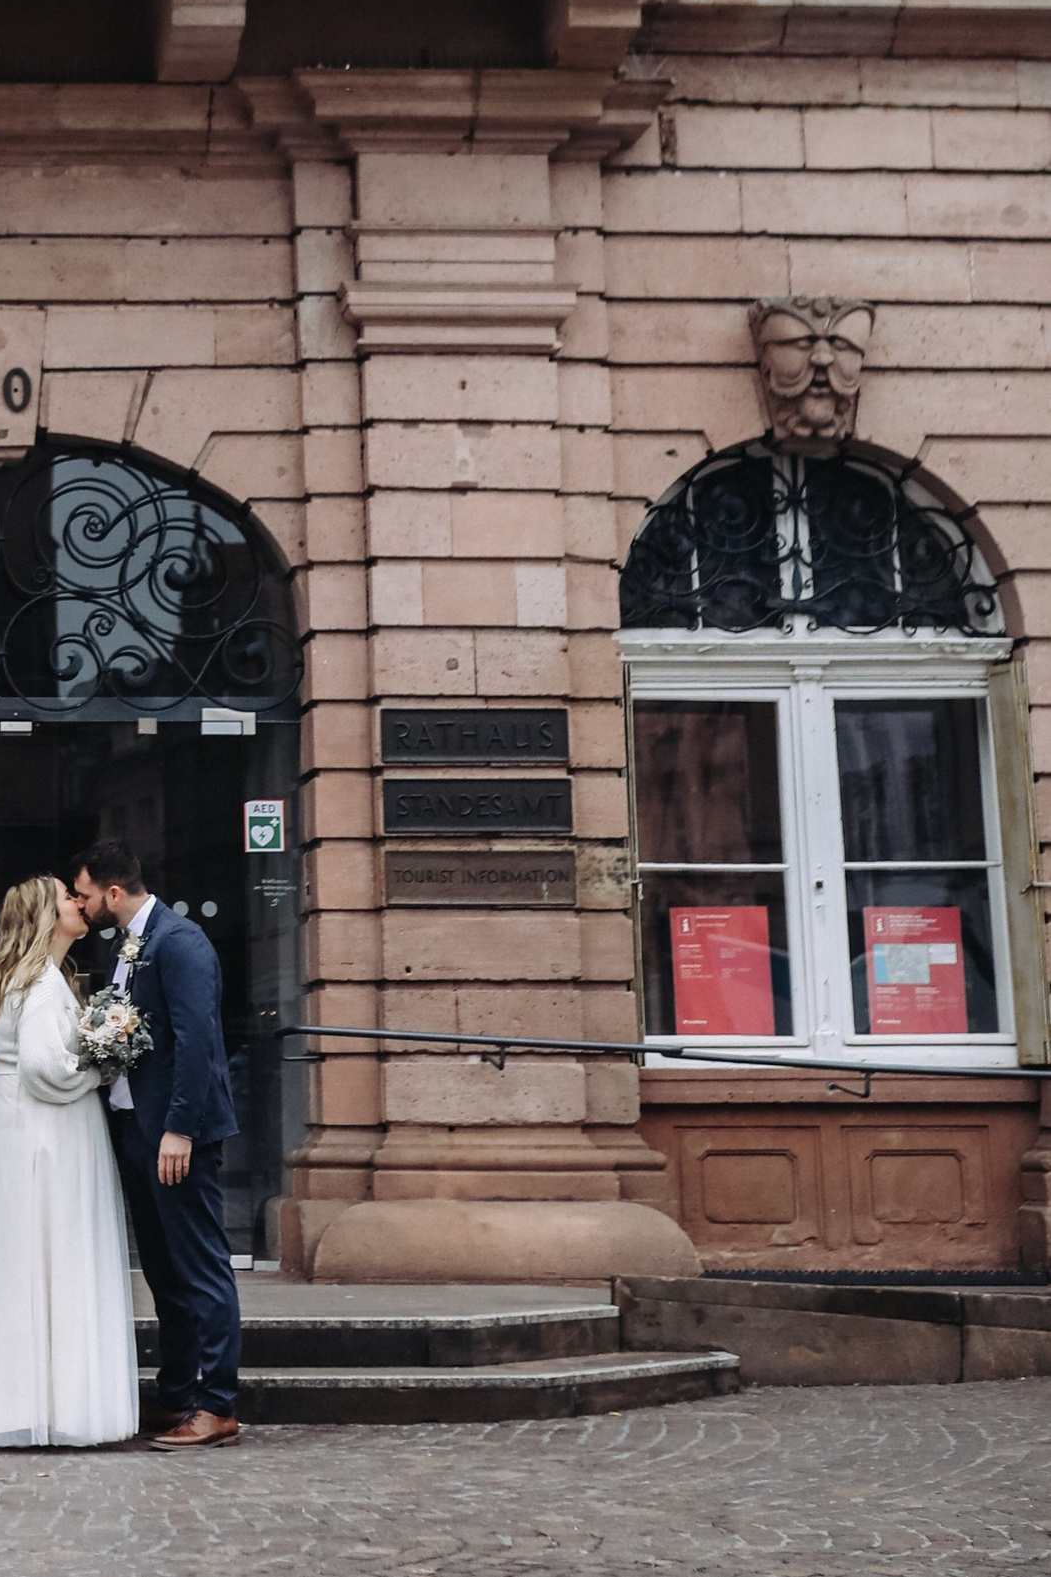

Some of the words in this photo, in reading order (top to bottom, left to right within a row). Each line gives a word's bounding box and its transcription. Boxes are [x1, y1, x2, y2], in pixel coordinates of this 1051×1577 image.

[396, 722, 554, 750] RATHAUS
[253, 804, 276, 813] AED
[397, 794, 563, 817] STANDESAMT
[393, 870, 455, 884] TOURIST
[462, 870, 570, 884] INFORMATION
